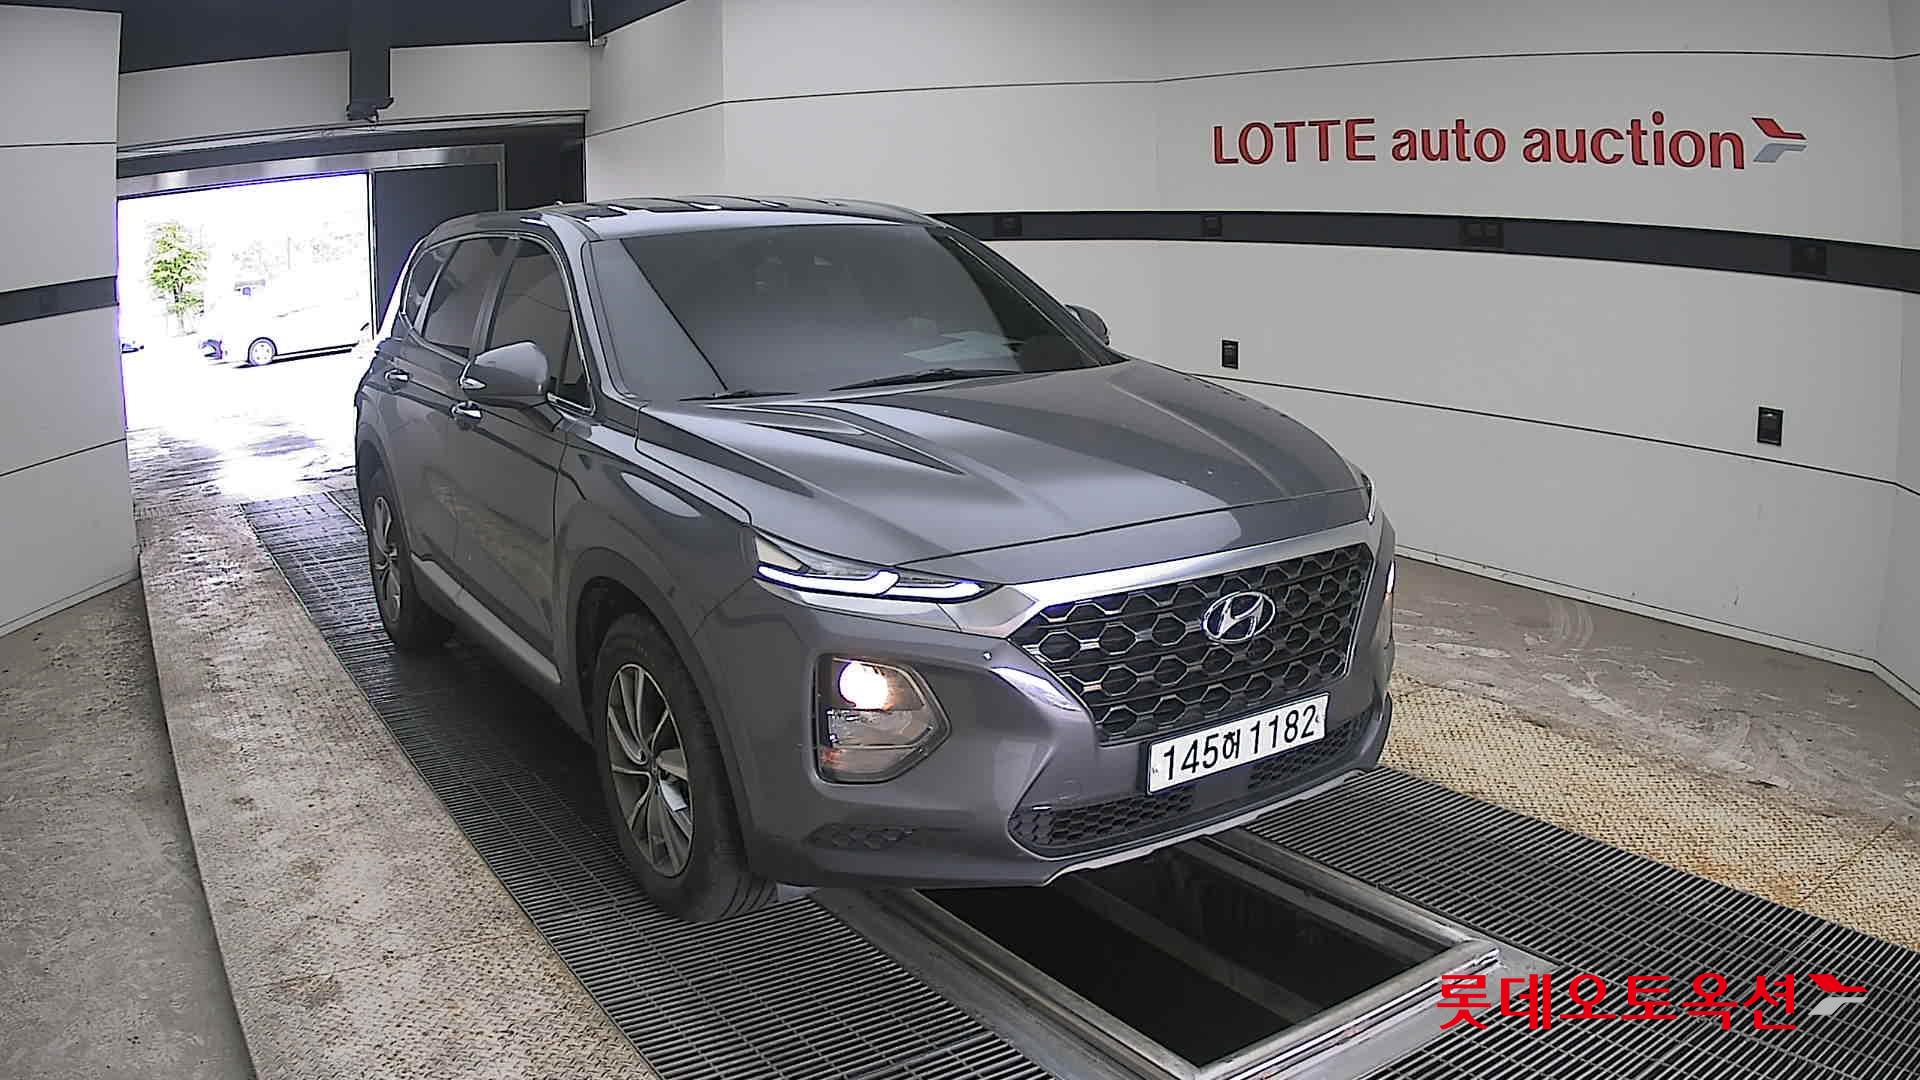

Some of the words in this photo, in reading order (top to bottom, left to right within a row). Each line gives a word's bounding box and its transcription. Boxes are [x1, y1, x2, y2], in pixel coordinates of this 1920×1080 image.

[1213, 118, 1376, 164] LOTTE
[1391, 118, 1506, 161] auto
[1522, 111, 1745, 170] auction
[1250, 704, 1317, 754] 1182
